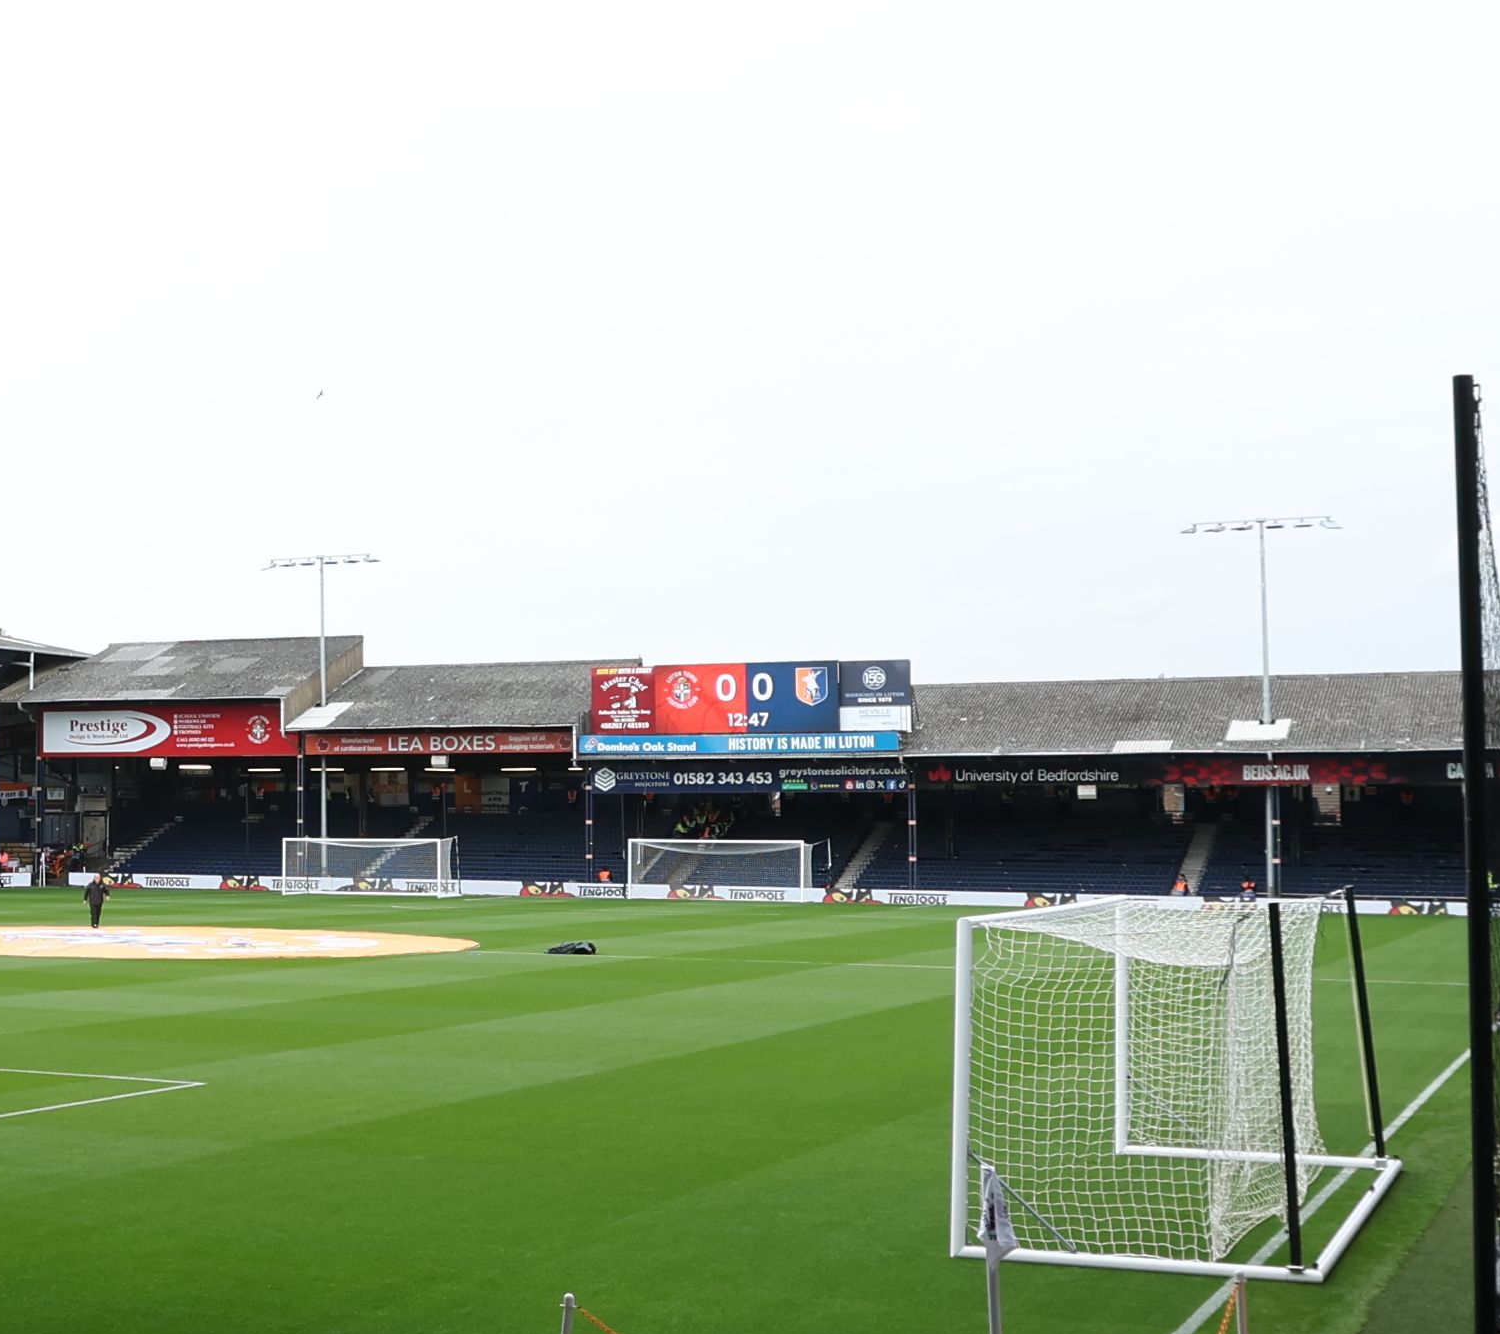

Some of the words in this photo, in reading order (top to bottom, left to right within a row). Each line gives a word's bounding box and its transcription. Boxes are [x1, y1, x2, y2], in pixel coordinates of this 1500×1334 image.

[600, 676, 627, 691] Master
[628, 676, 648, 691] Chef
[716, 673, 737, 701] 0
[752, 672, 773, 701] 0
[728, 707, 769, 727] 12:47
[70, 719, 127, 734] Prestige
[388, 737, 423, 752] LEA
[430, 736, 496, 752] BOXES
[597, 741, 640, 752] Domino's
[643, 742, 664, 752] Oak
[667, 741, 696, 752] Stand
[728, 737, 774, 750] HISTORY
[777, 737, 788, 750] IS
[791, 737, 821, 750] MADE
[824, 737, 836, 749] IN
[839, 736, 875, 749] LUTON
[616, 771, 670, 780] GREYSTONE
[673, 773, 713, 785] 01582
[718, 773, 743, 784] 343
[746, 772, 772, 784] 453
[779, 766, 907, 778] greystonesolicitors.co.uk
[955, 769, 1018, 783] University
[1020, 768, 1033, 781] of
[1038, 769, 1119, 781] Bedfordshire
[1243, 765, 1310, 781] BEDS.AC.UK
[144, 877, 190, 888] TENGTOOLS
[728, 888, 785, 901] TENGTOOLS
[888, 892, 949, 905] TENGTOOLS
